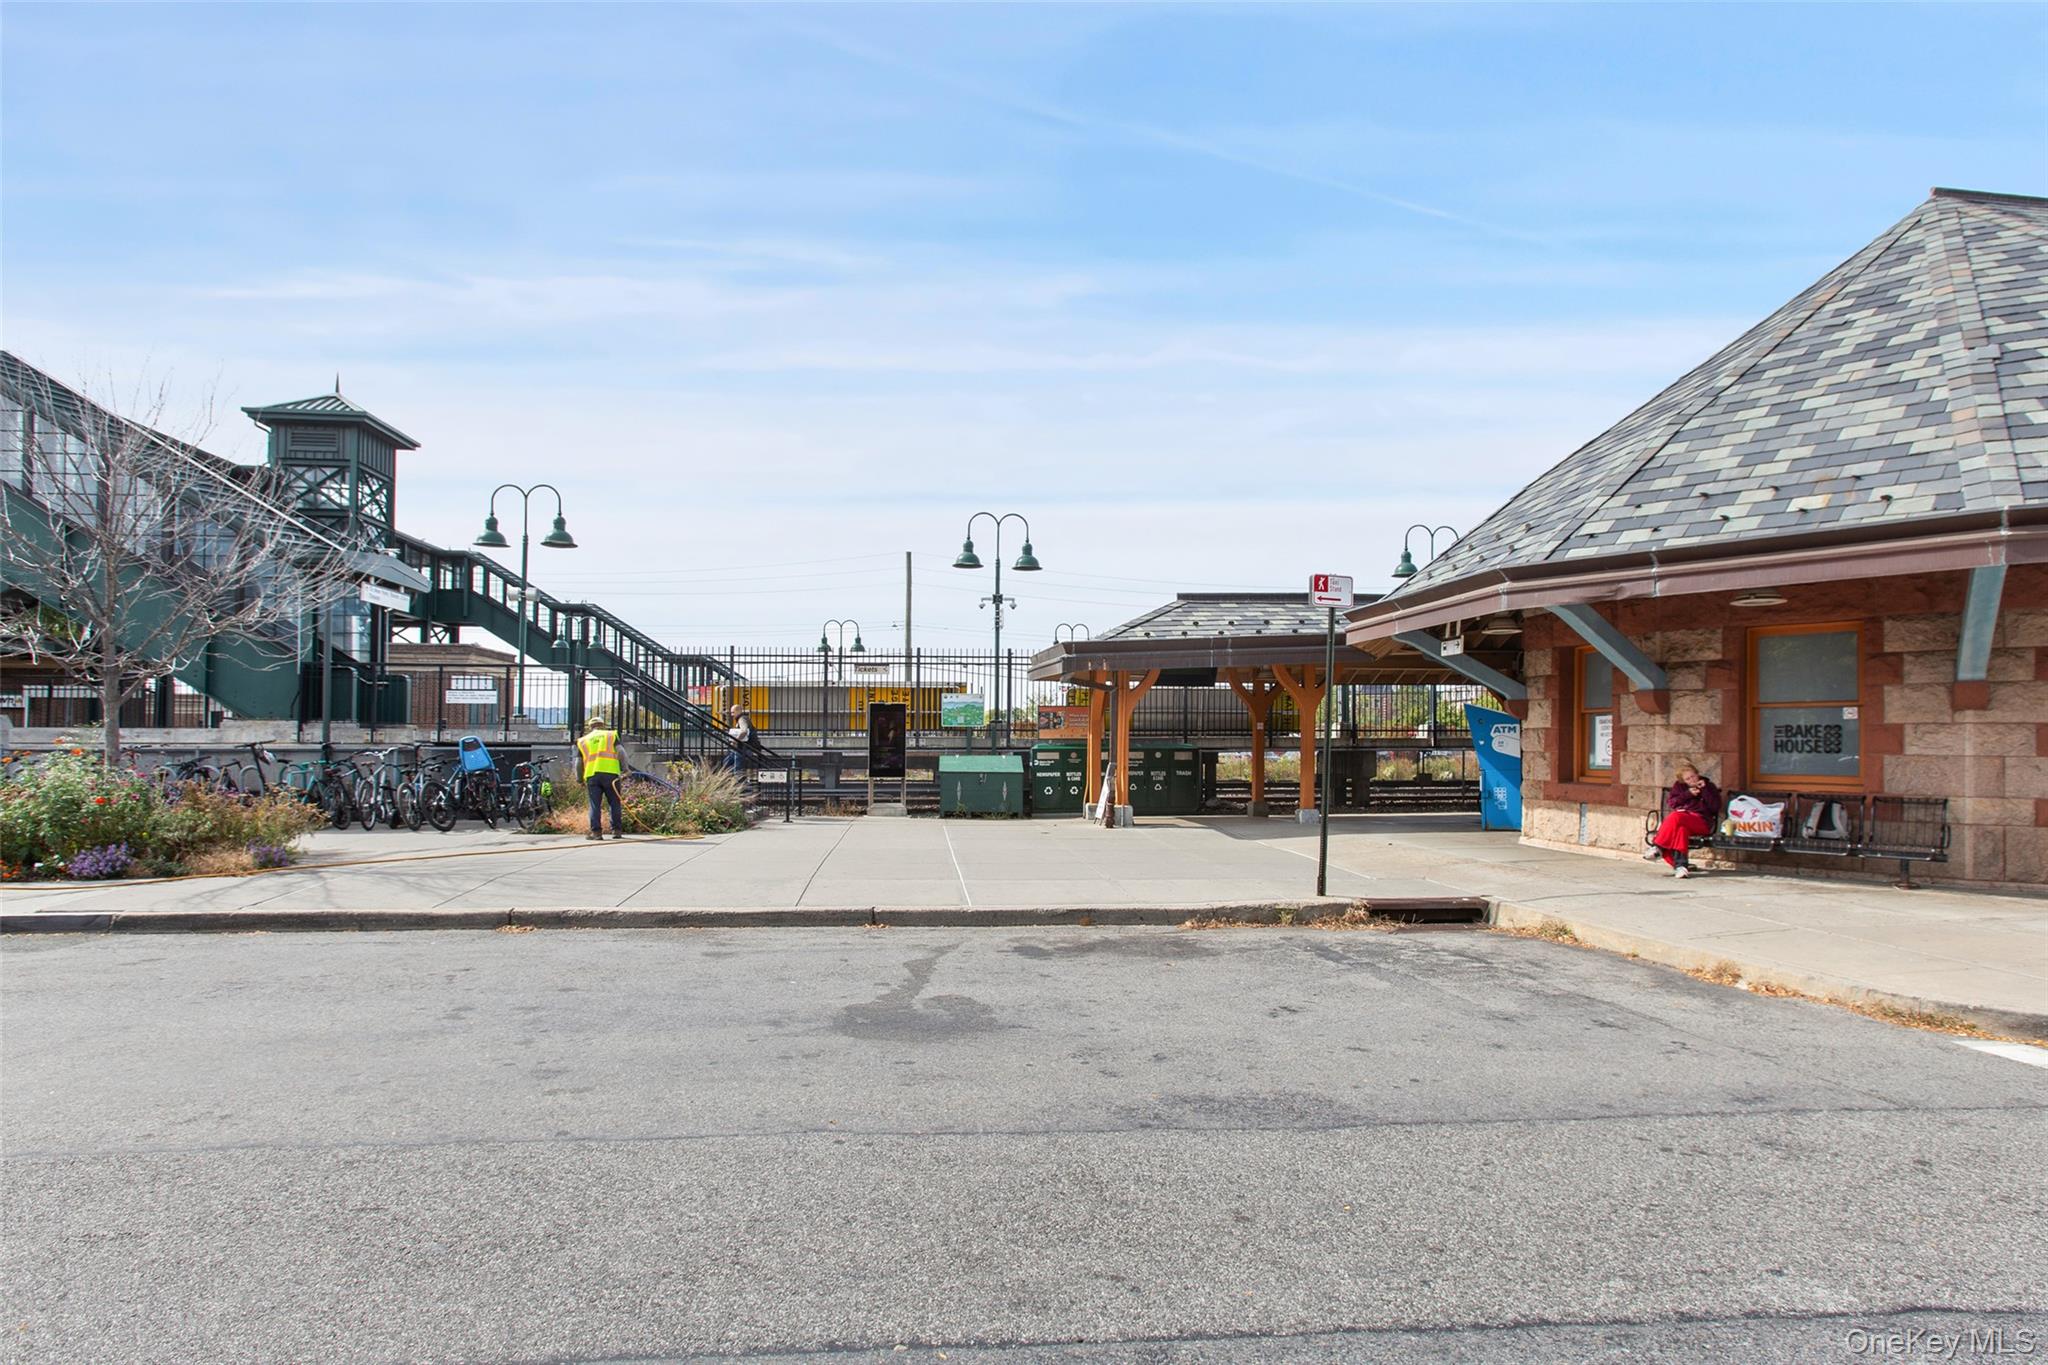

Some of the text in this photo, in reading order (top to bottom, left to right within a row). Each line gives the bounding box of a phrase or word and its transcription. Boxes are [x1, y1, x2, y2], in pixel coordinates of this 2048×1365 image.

[1493, 725, 1517, 734] ATM
[1784, 724, 1822, 738] BAKE
[1774, 740, 1822, 753] HOUSE
